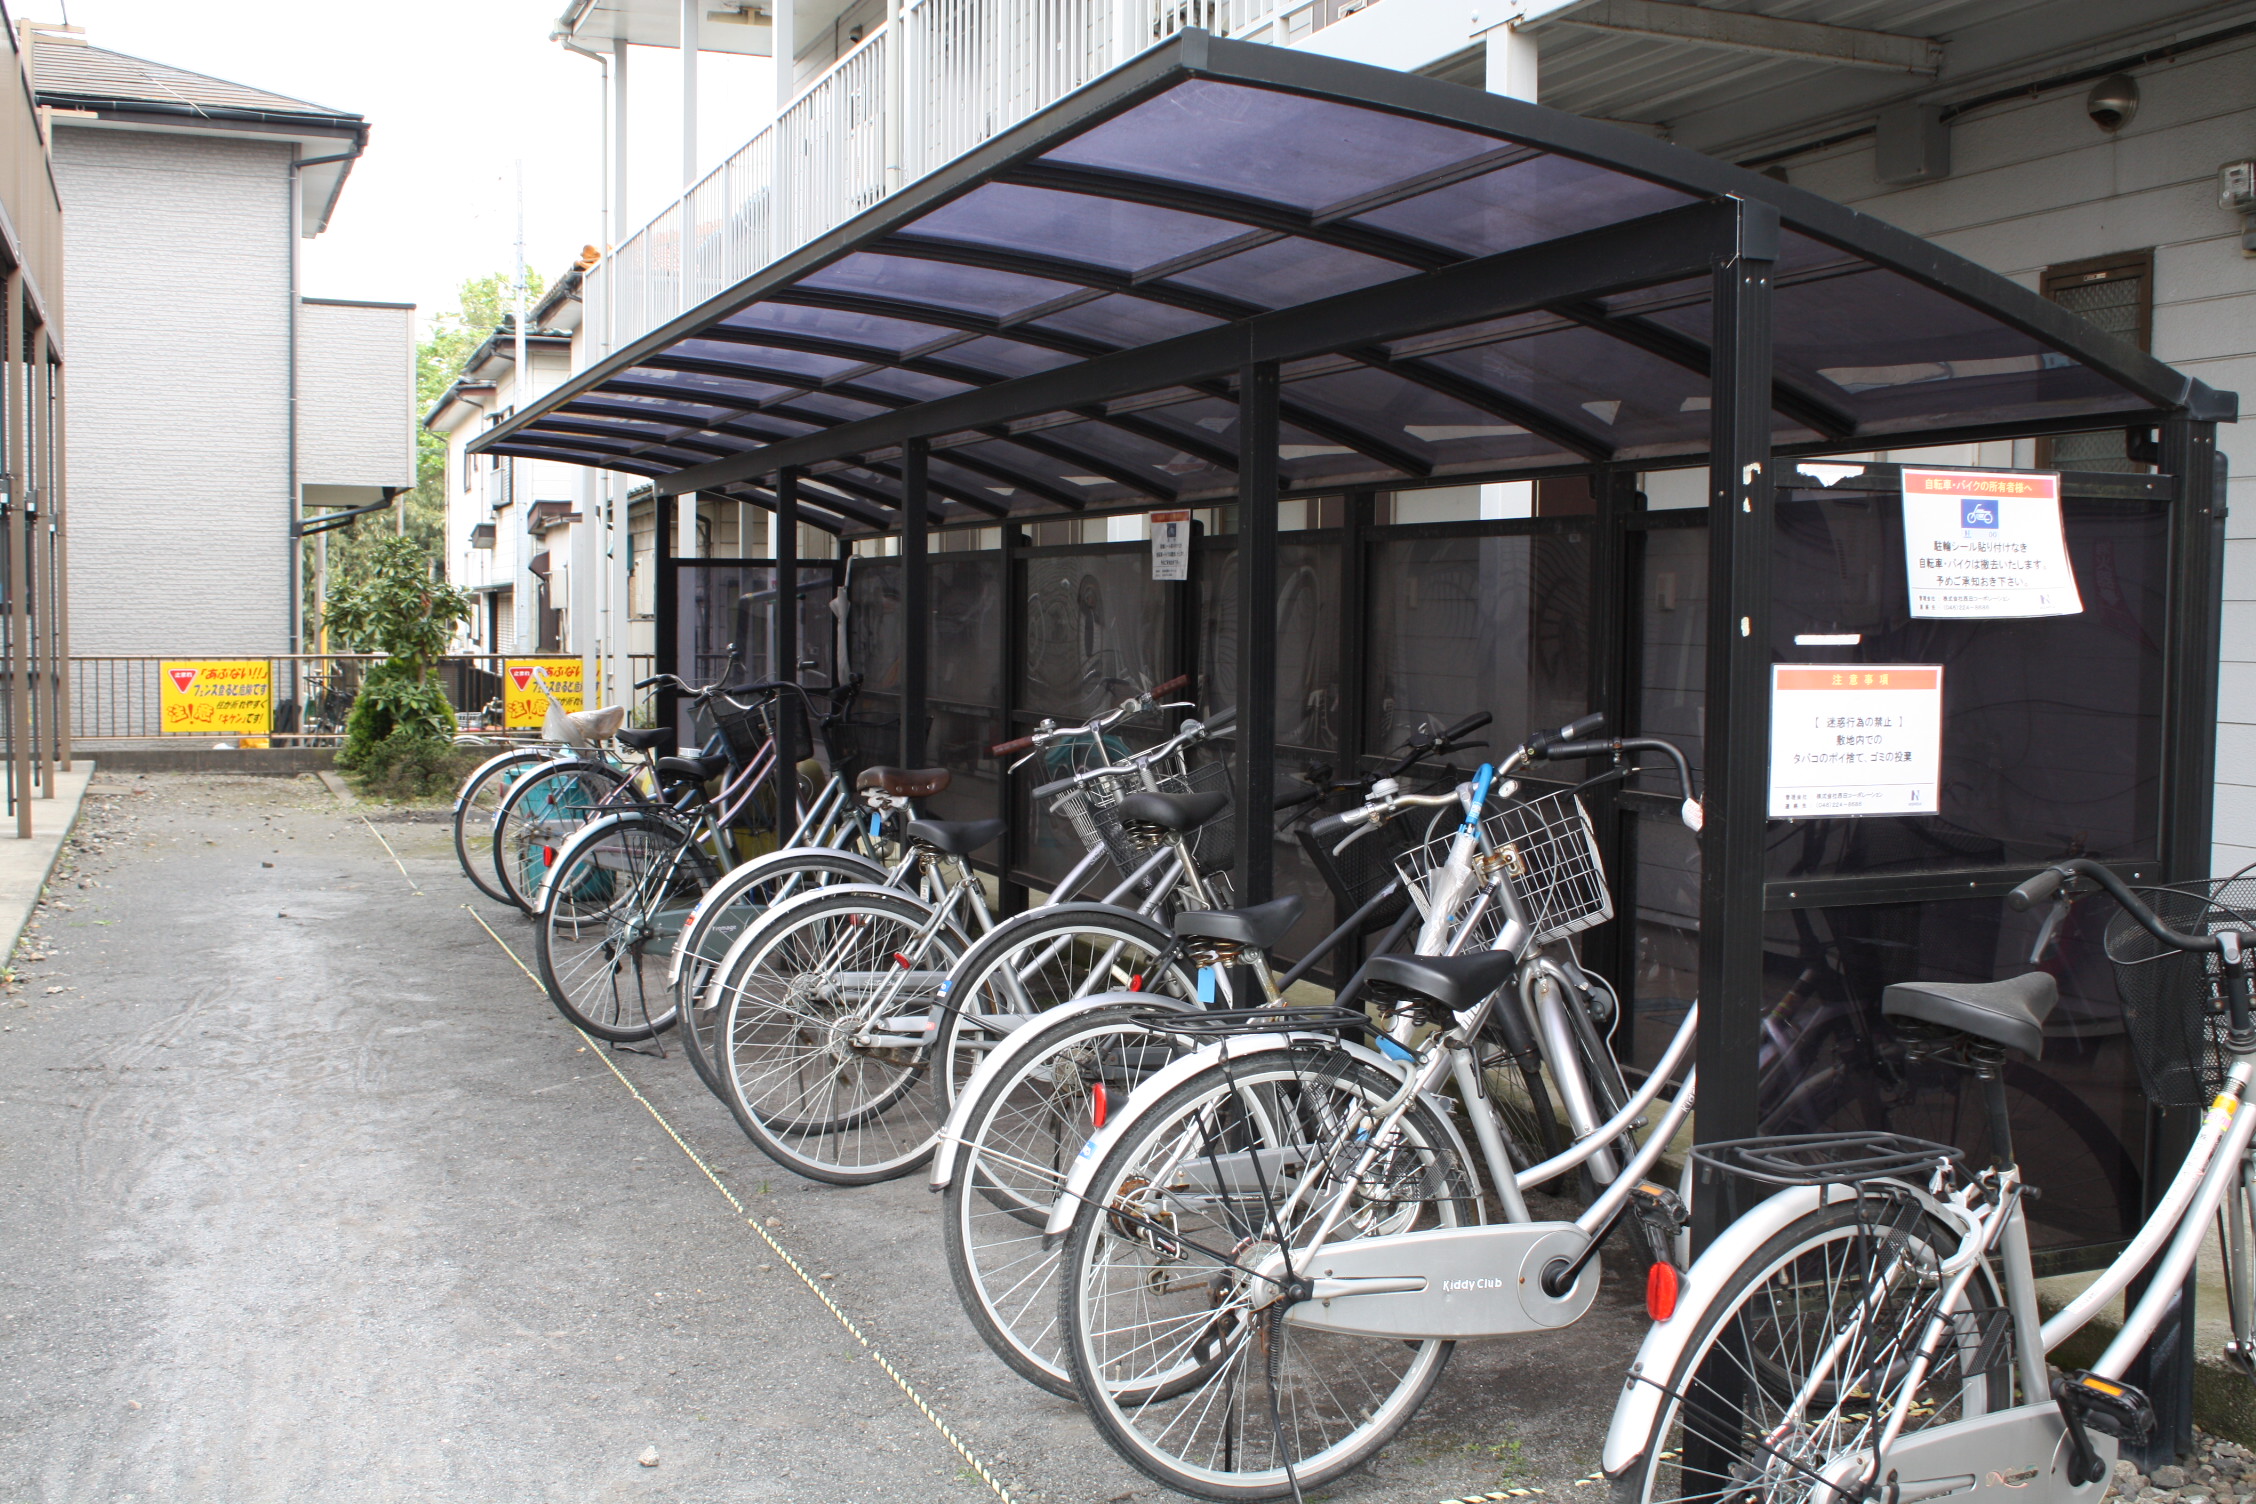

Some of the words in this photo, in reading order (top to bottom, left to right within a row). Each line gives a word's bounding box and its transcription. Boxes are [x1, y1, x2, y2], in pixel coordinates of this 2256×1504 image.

[1924, 478, 2033, 493] 自転車・バイクの所有者様へ
[1933, 540, 2028, 553] 駐輪シール貼り付けなき
[1919, 558, 2048, 570] 自転車・バイクは撤去いたします。
[1936, 576, 2029, 587] 予めご承知おき下さい。
[1831, 674, 1890, 686] 注意事項
[1835, 734, 1882, 745] 敷地内での
[1793, 751, 1912, 763] タバコのポイ捨て、ゴミの投棄
[1442, 1280, 1476, 1292] Kiddy
[1477, 1278, 1503, 1289] Club
